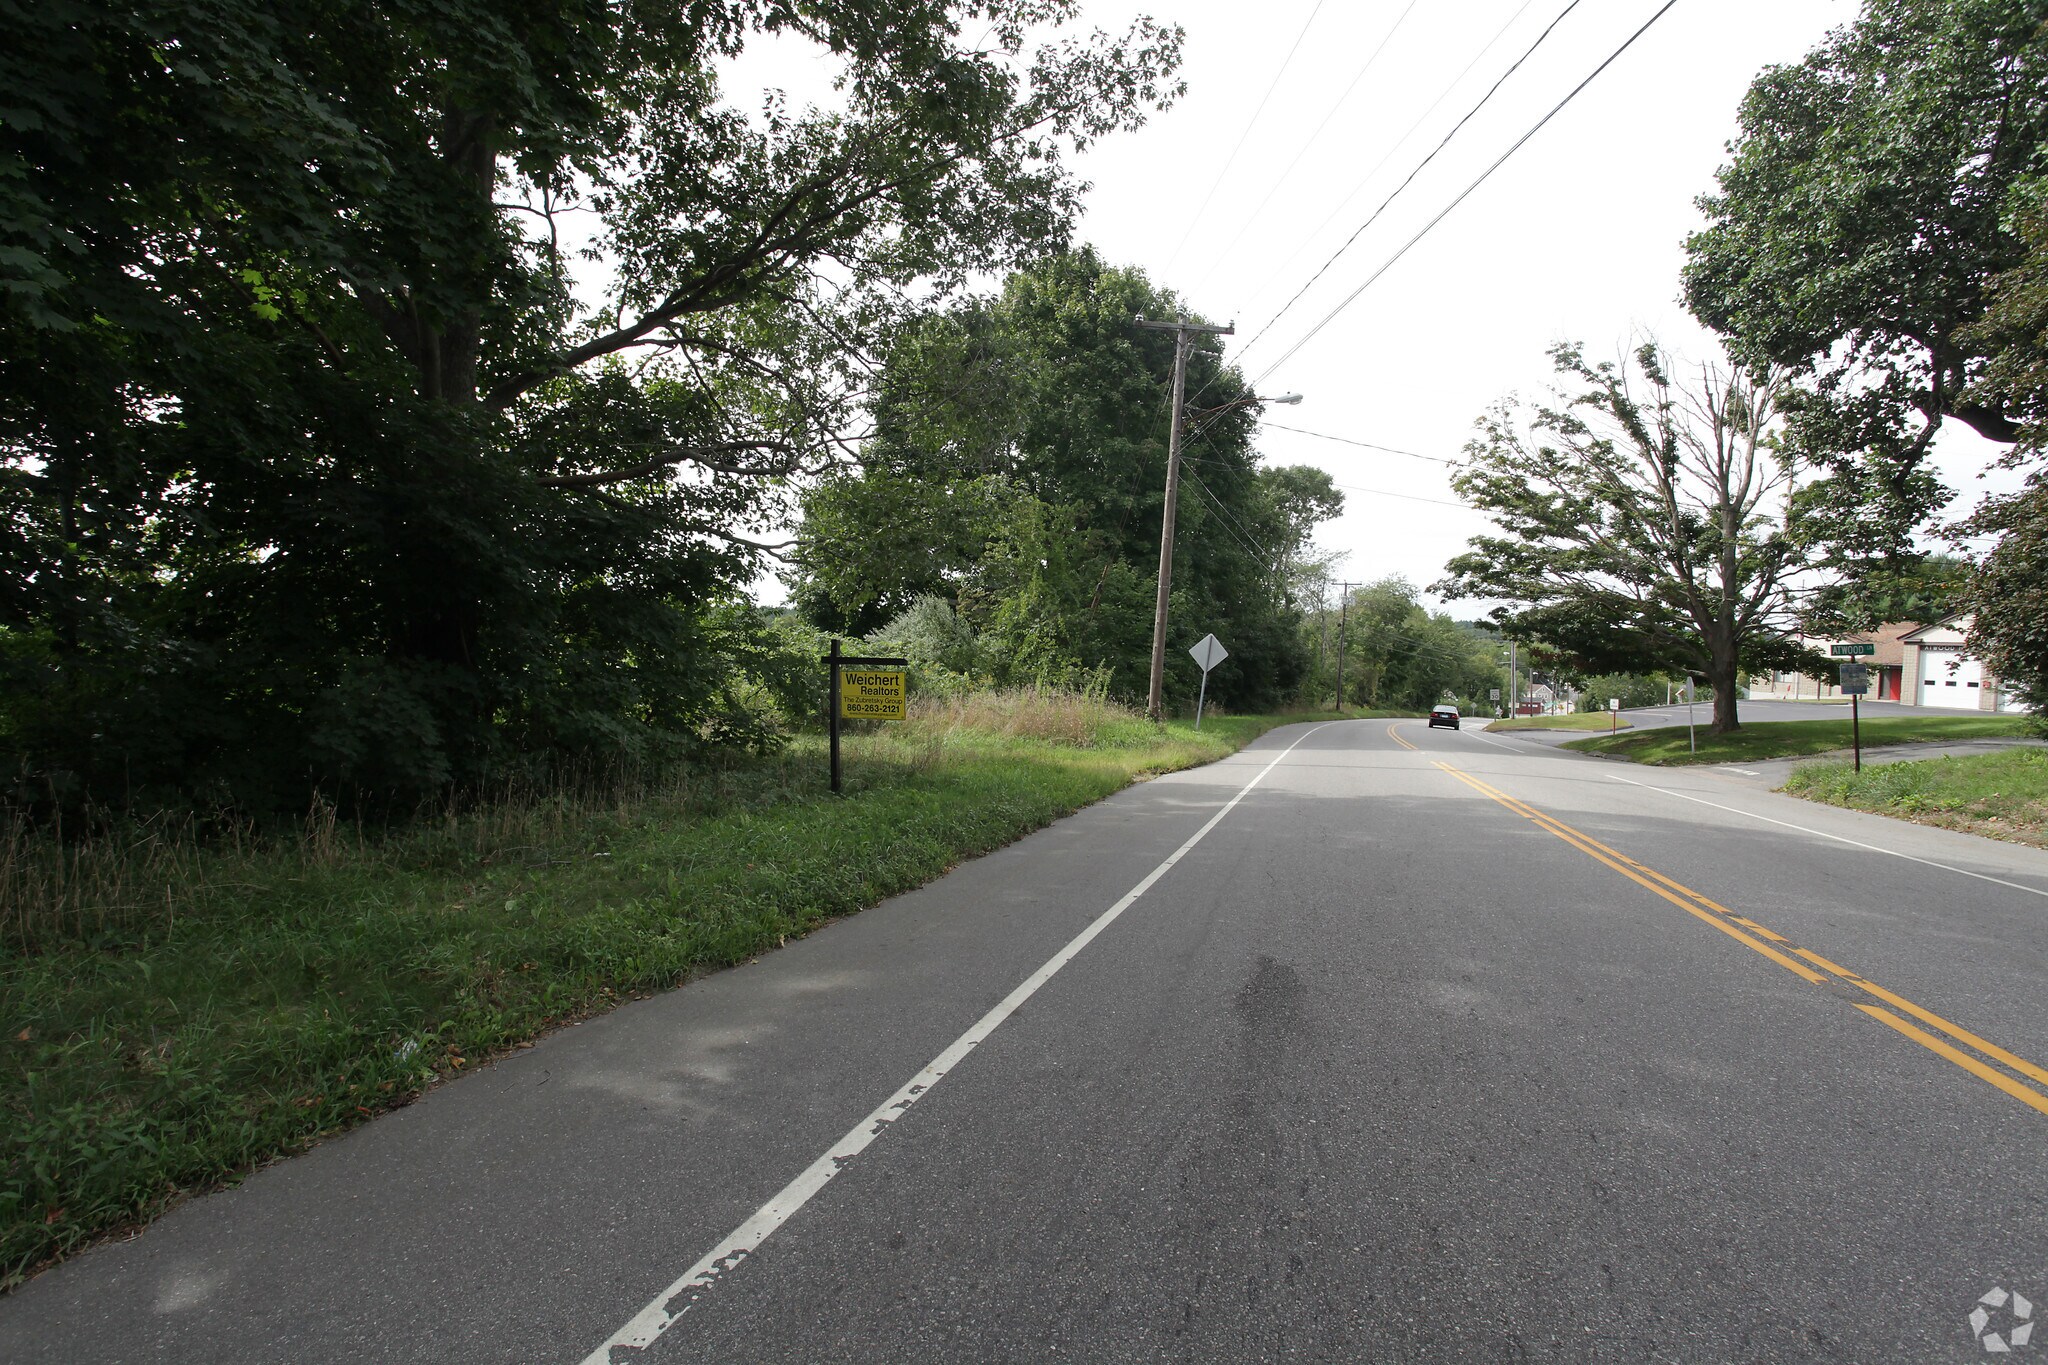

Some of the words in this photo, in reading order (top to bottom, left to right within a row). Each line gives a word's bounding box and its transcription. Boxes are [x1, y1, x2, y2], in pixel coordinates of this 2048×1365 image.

[1832, 645, 1864, 655] ATWOOD
[845, 673, 899, 686] Weichert
[860, 686, 899, 696] Realtors
[847, 704, 900, 713] 860-263-2121
